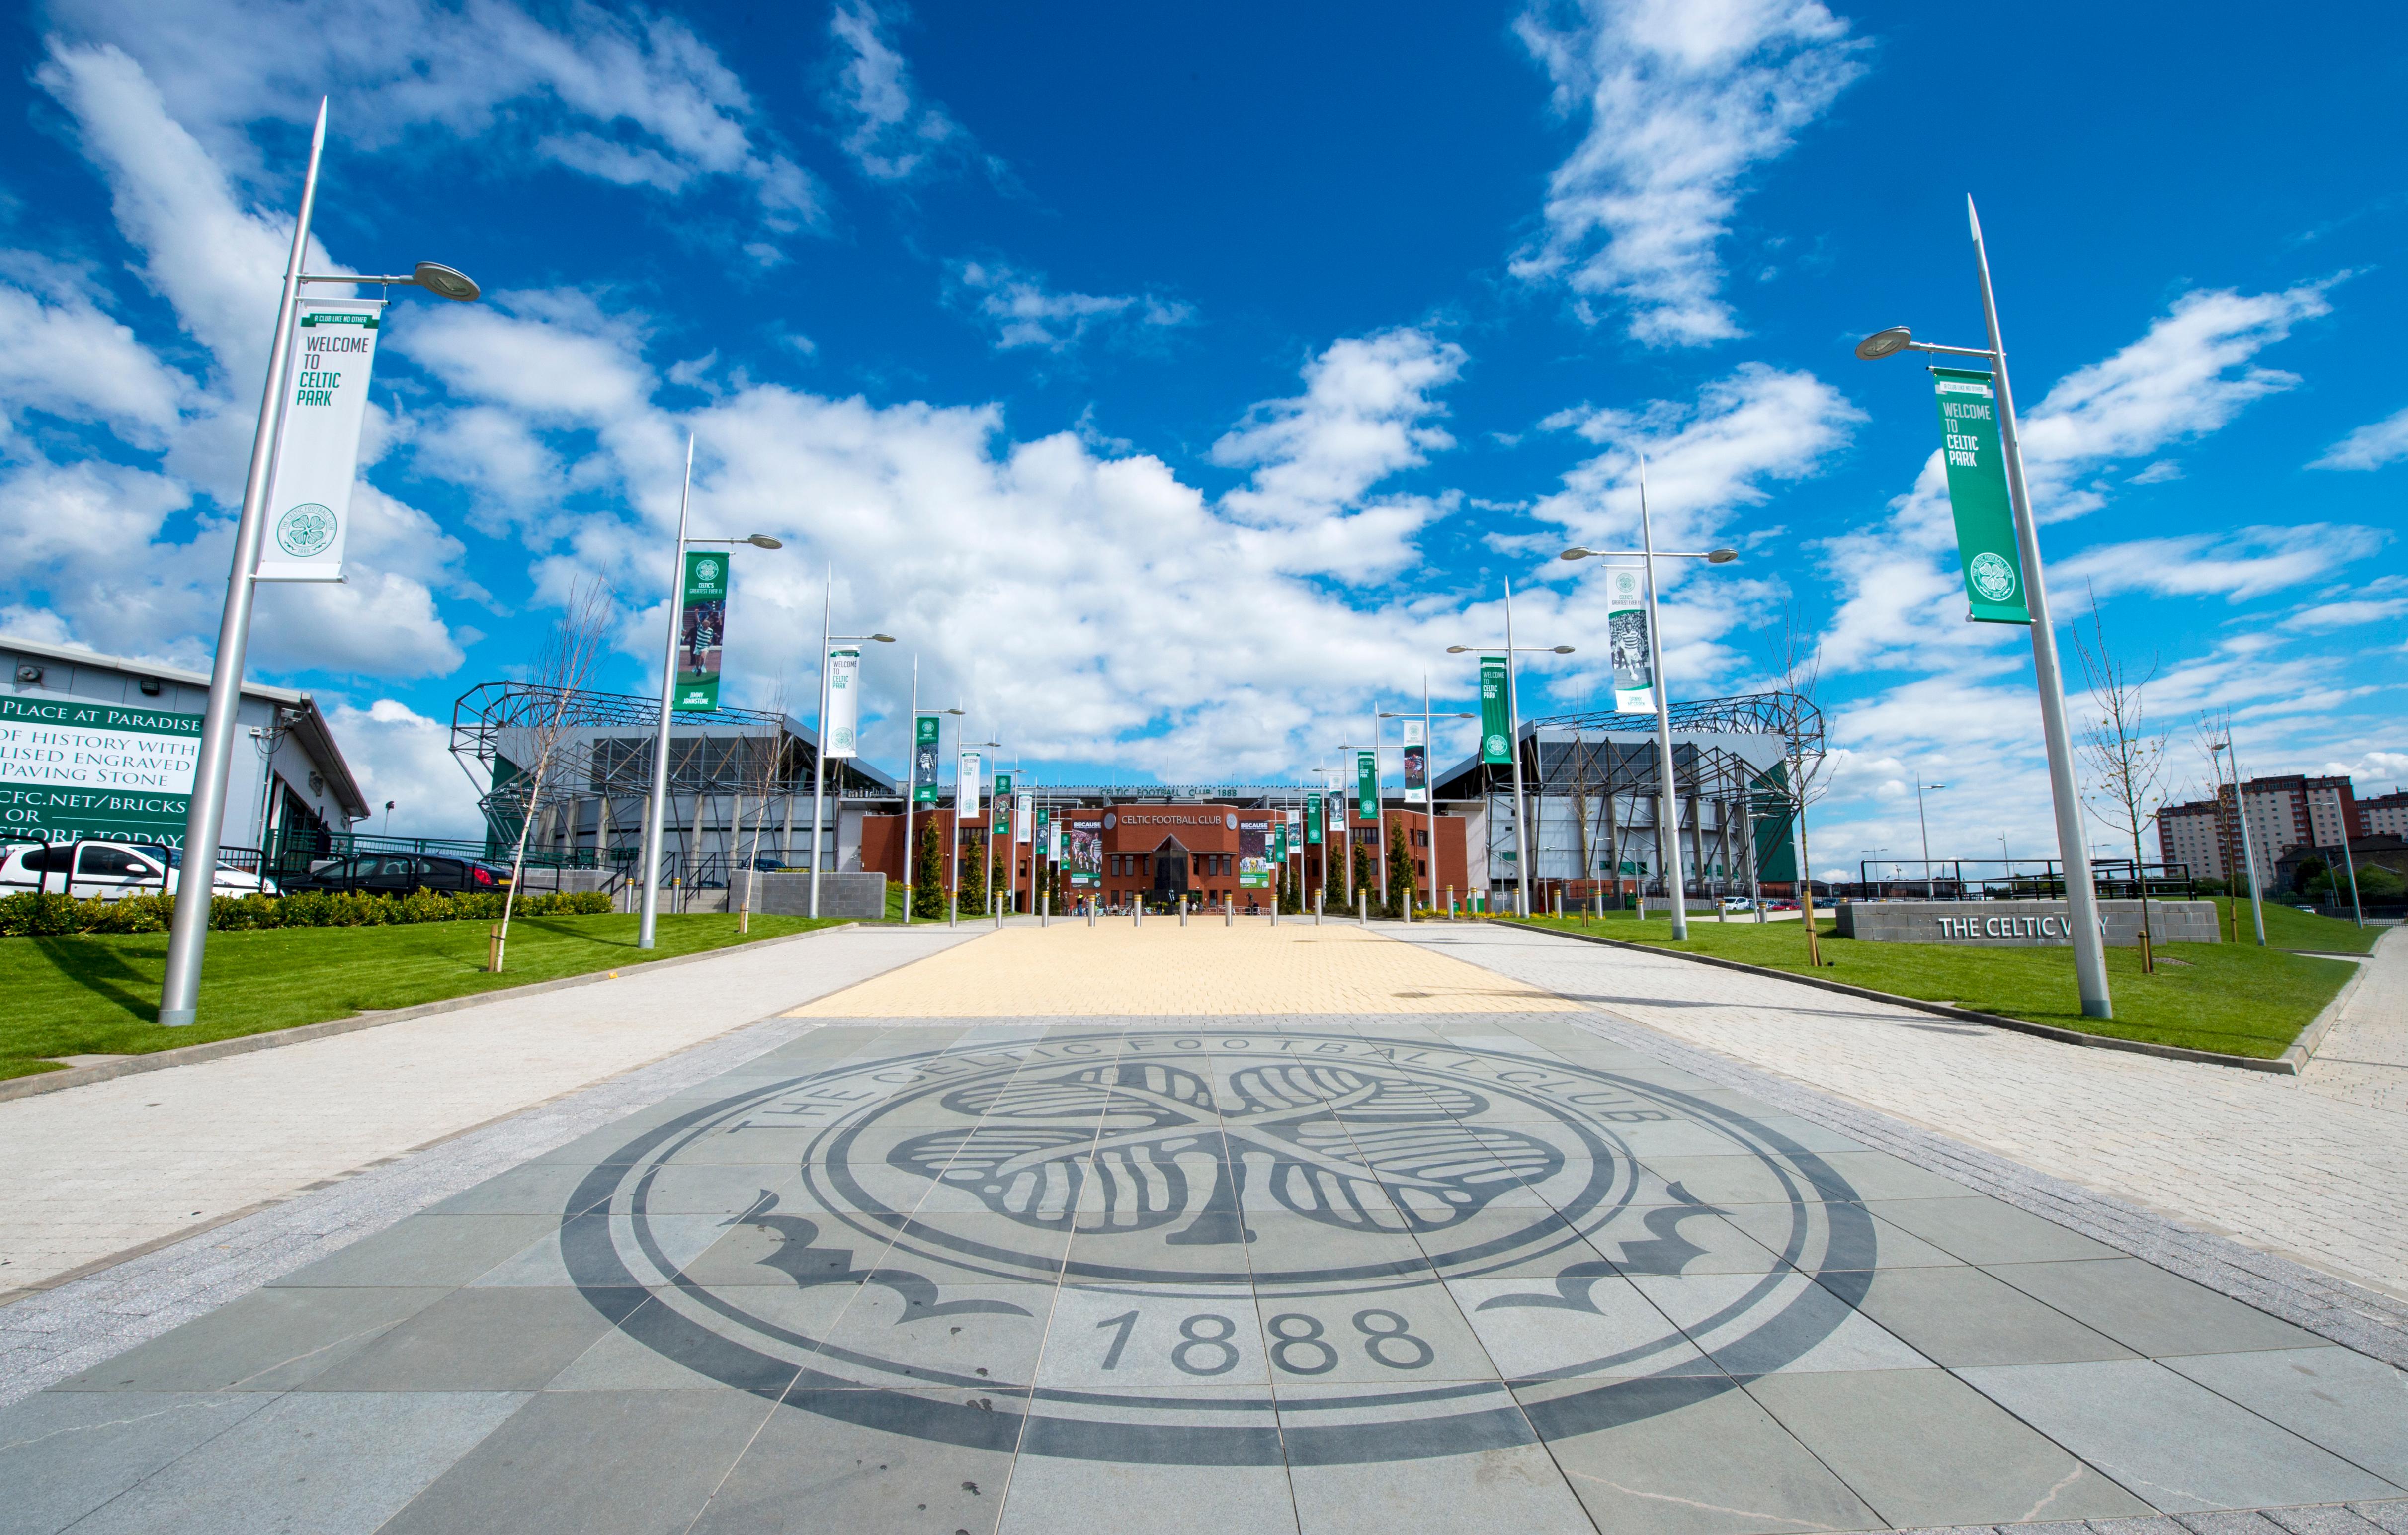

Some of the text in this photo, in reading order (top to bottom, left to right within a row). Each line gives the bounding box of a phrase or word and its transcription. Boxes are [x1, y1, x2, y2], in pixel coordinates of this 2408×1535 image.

[307, 336, 369, 353] WELCOME
[304, 354, 320, 369] TO
[299, 372, 341, 388] CELTIC
[296, 390, 332, 406] PARK
[1943, 402, 1991, 420] WELCOME
[1945, 418, 1958, 433] TO
[1947, 434, 1979, 451] CELTIC
[1948, 450, 1977, 467] PARK
[281, 520, 290, 530] THE
[288, 507, 304, 521] CELTIC
[305, 506, 329, 518] FOOTBALL
[2, 701, 201, 732] PLACE AT PARADISE
[31, 731, 130, 750] HISTORY
[138, 740, 196, 756] WITH
[74, 752, 190, 771] ENGRAVED
[2, 762, 168, 787] PAVING STONE
[5, 809, 42, 823] OR
[1121, 816, 1221, 824] CELTIC FOOTBALL CLUB
[1938, 918, 1980, 937] THE
[1986, 917, 2056, 936] CELTIC
[726, 1039, 1671, 1134] THE CELTIC FOOTBALL CLUB
[1095, 1309, 1435, 1376] 1888
